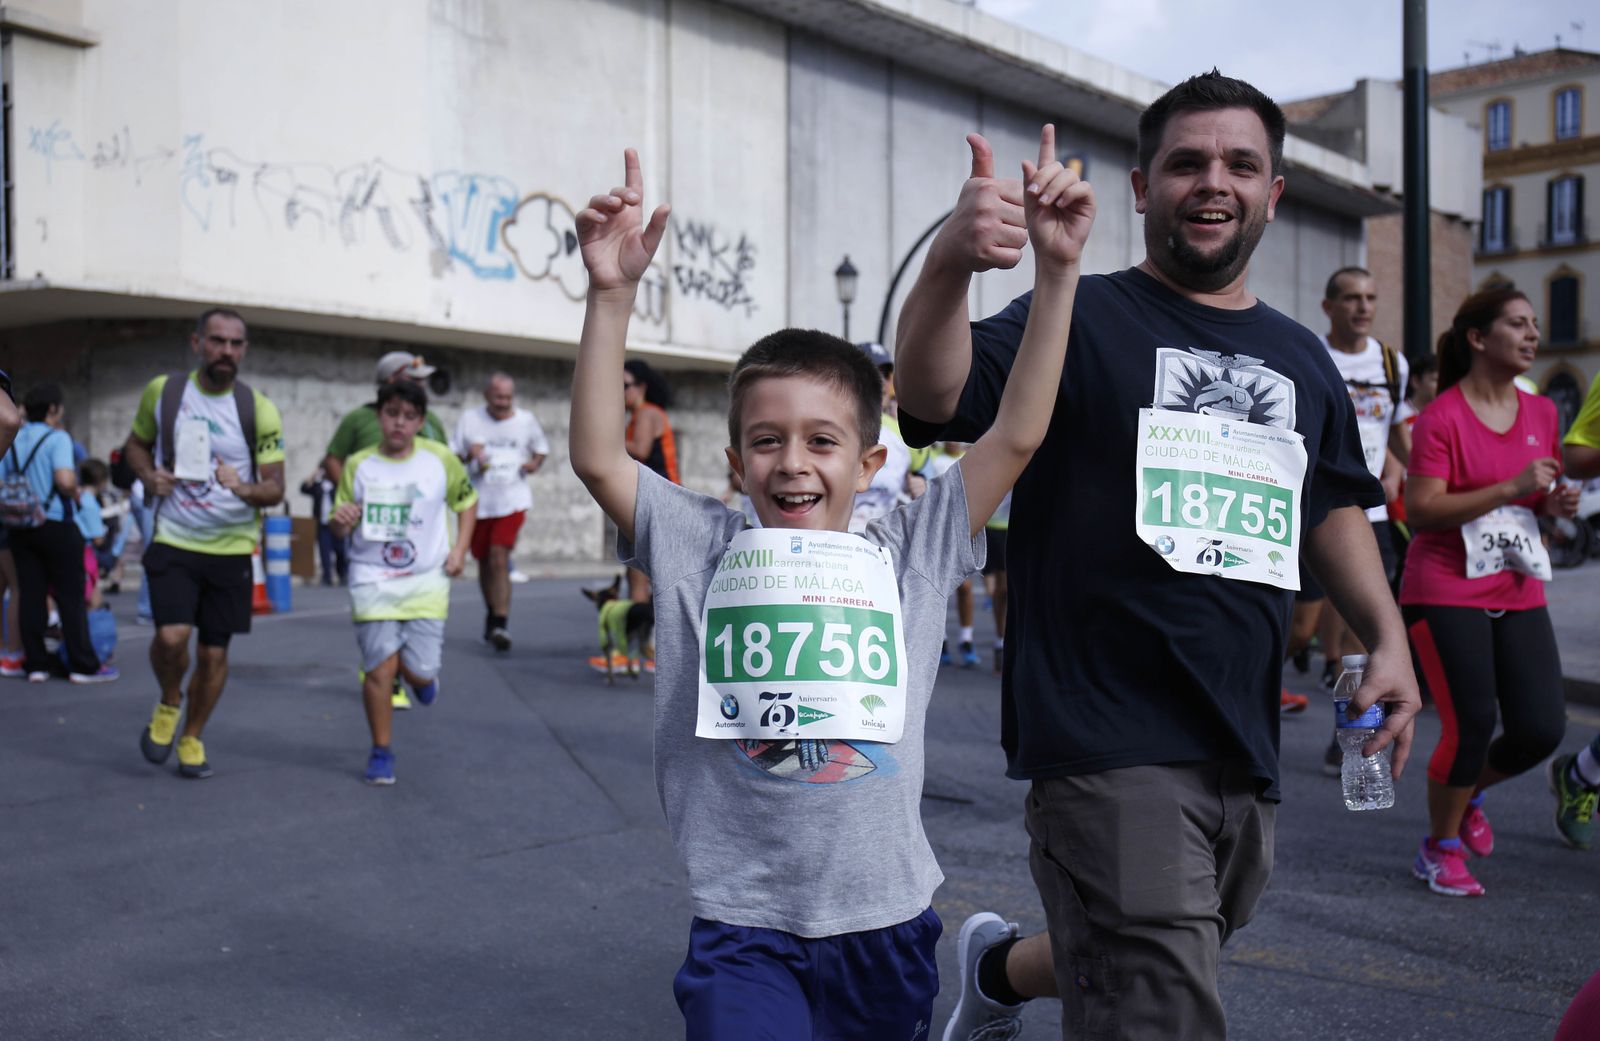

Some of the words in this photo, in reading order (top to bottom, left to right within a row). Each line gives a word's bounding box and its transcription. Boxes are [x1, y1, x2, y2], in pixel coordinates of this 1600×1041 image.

[1147, 425, 1210, 444] XXXVIII
[1211, 440, 1235, 450] carrera
[1144, 445, 1199, 460] CIUDAD
[1203, 450, 1220, 463] DE
[1222, 454, 1273, 473] MÁLAGA
[1228, 470, 1245, 478] MINI
[1246, 473, 1278, 485] CARRERA
[1151, 482, 1288, 541] 18755
[1481, 532, 1533, 553] 3541
[719, 549, 773, 574] XXXVIII
[774, 558, 812, 569] carrera
[815, 557, 849, 572] urbana
[711, 575, 758, 594] CIUDAD
[764, 575, 787, 589] DE
[794, 572, 865, 594] MÁLAGA
[802, 595, 826, 603] MINI
[829, 596, 875, 608] CARRERA
[714, 622, 891, 680] 18756
[758, 691, 796, 727] 75
[714, 721, 746, 729] Automotor
[861, 719, 886, 729] Unicaja
